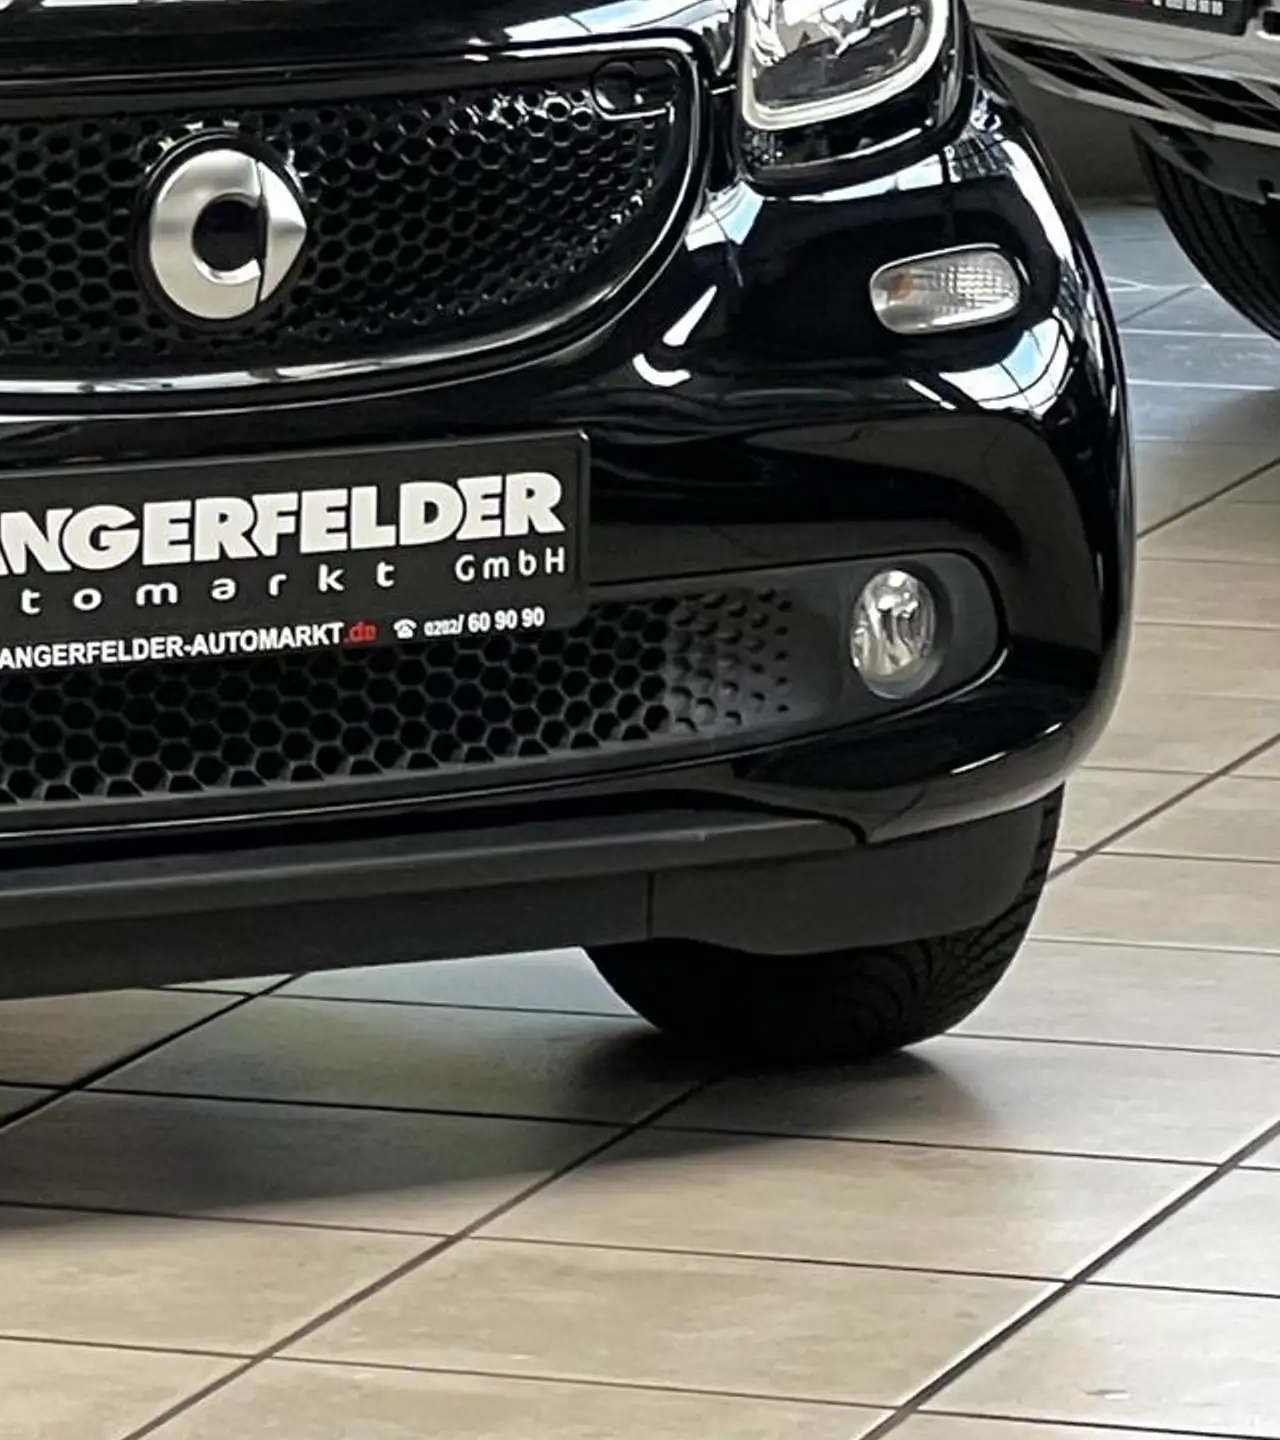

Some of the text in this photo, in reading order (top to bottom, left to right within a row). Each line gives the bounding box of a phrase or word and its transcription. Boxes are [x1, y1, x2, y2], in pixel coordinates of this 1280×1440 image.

[455, 546, 566, 582] GmbH
[467, 611, 490, 633] 60
[494, 609, 518, 630] 90
[521, 606, 545, 628] 90
